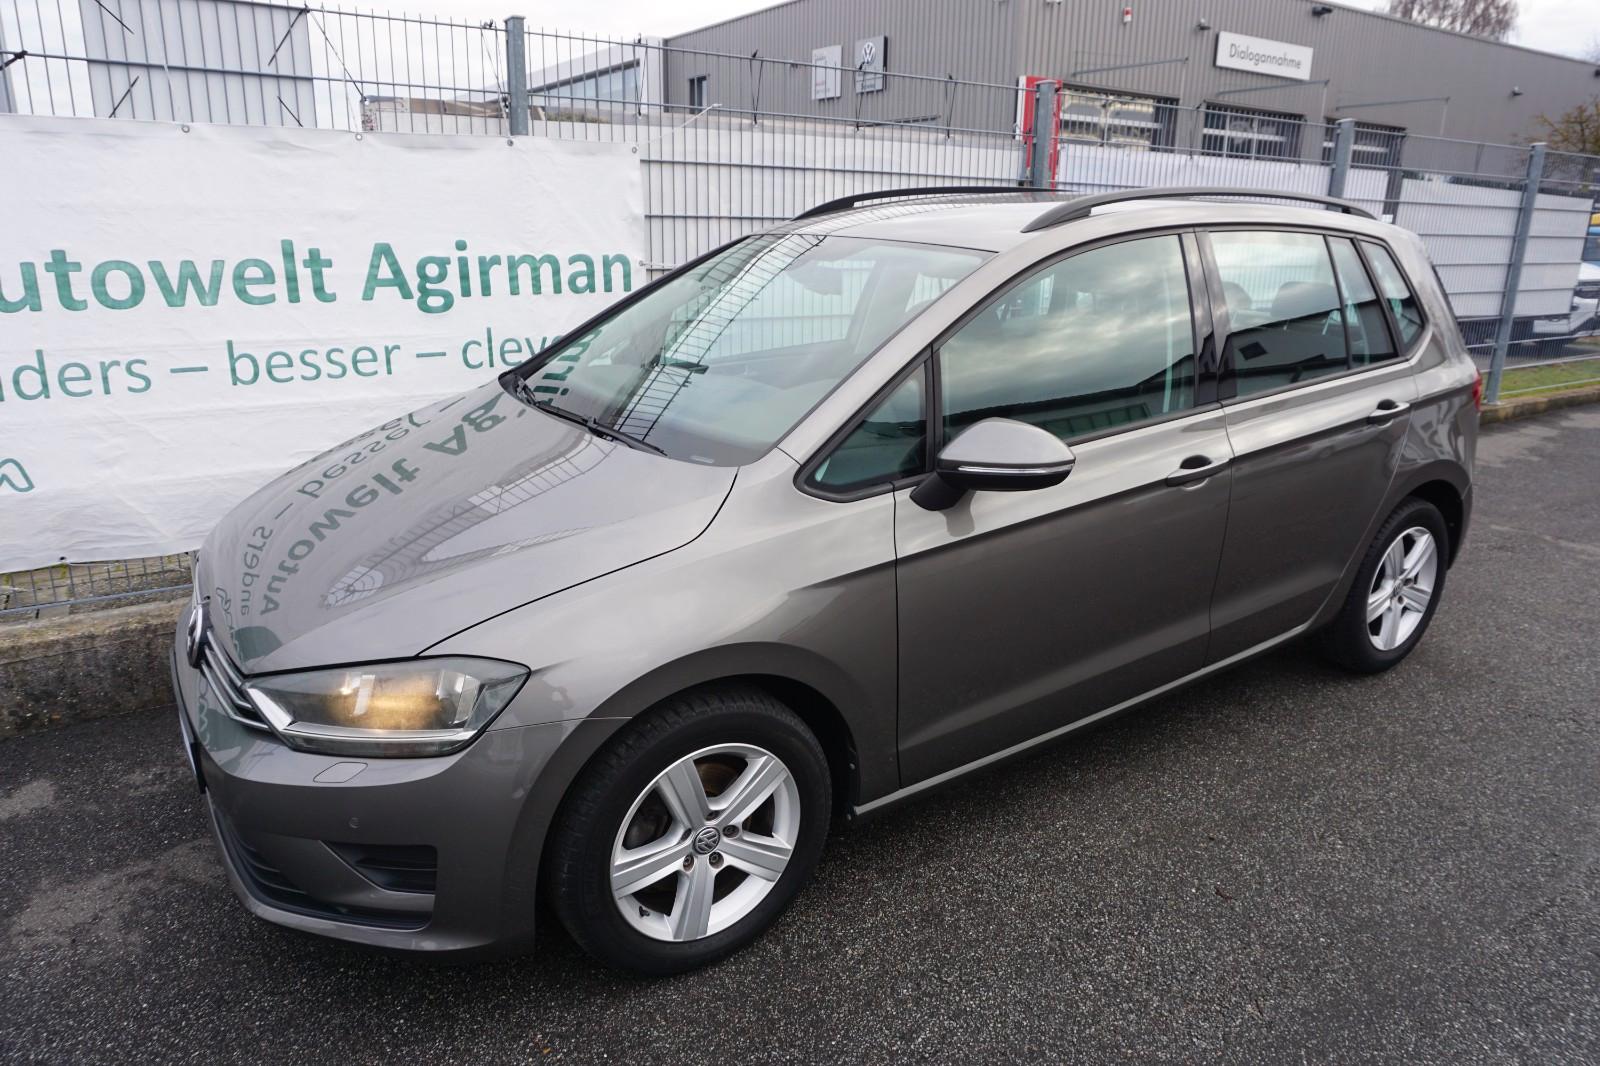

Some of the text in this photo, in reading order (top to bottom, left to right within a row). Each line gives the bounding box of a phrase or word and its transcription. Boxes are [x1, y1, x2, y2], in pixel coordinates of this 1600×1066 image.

[1229, 43, 1301, 69] Dialogannahme
[361, 240, 632, 315] Agirman
[0, 350, 150, 400] ders
[226, 340, 400, 384] besser
[458, 326, 558, 369] clev
